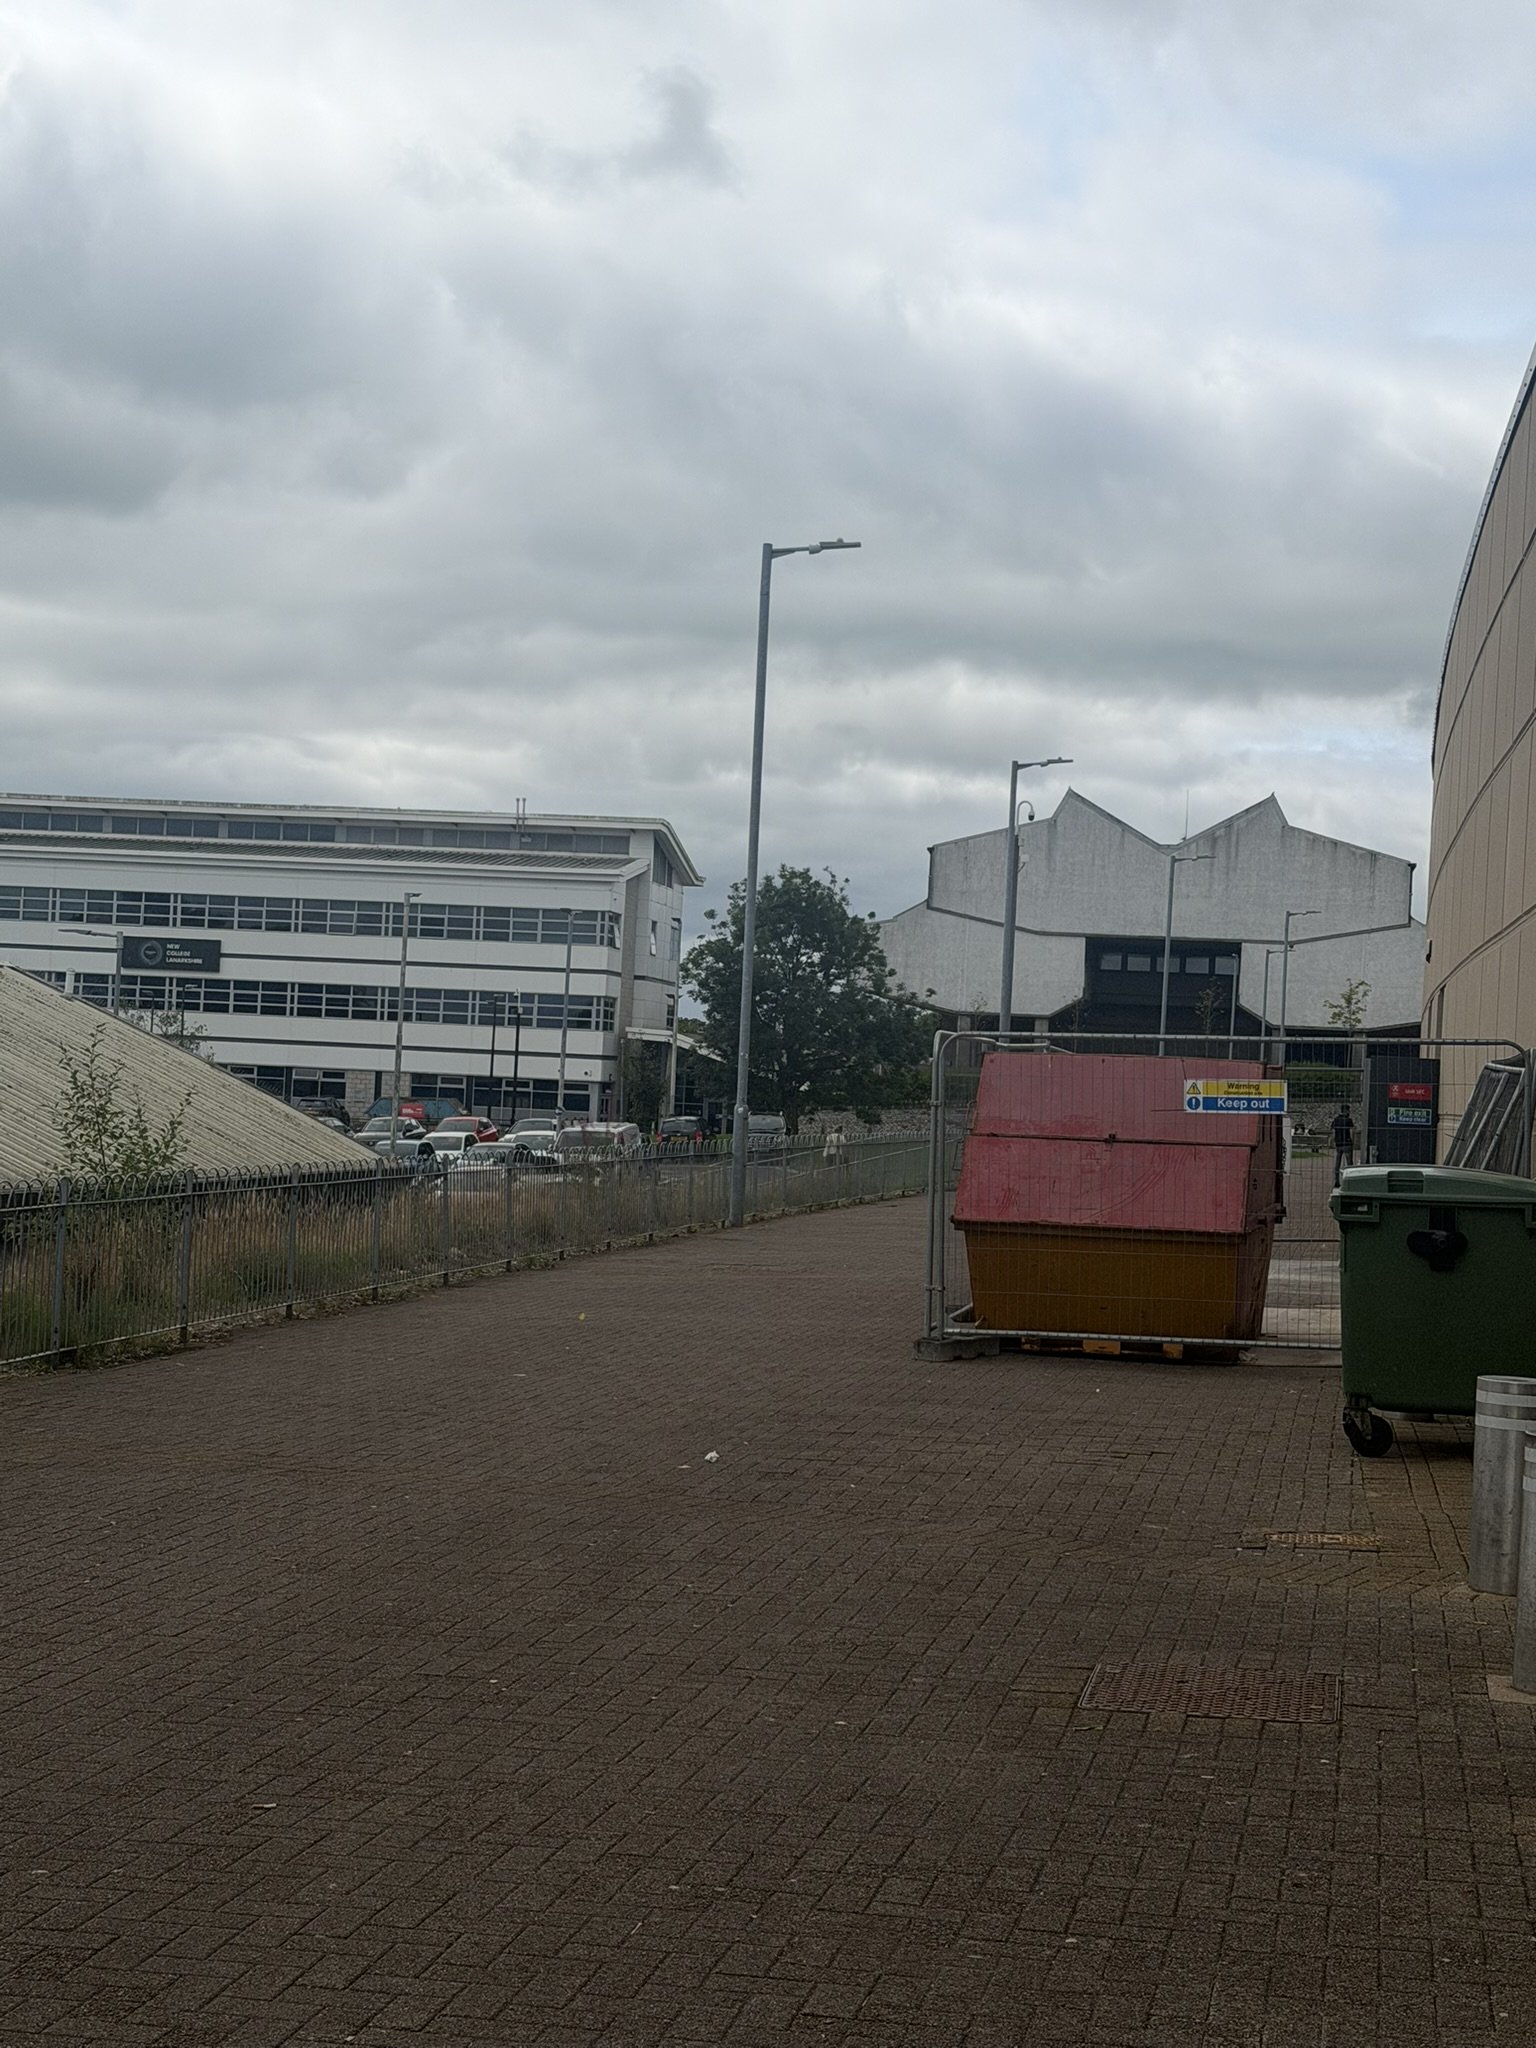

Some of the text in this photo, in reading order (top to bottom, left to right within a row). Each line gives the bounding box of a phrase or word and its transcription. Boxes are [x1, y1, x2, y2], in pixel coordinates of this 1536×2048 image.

[1226, 1082, 1260, 1091] Warning
[1217, 1098, 1270, 1109] Keep out
